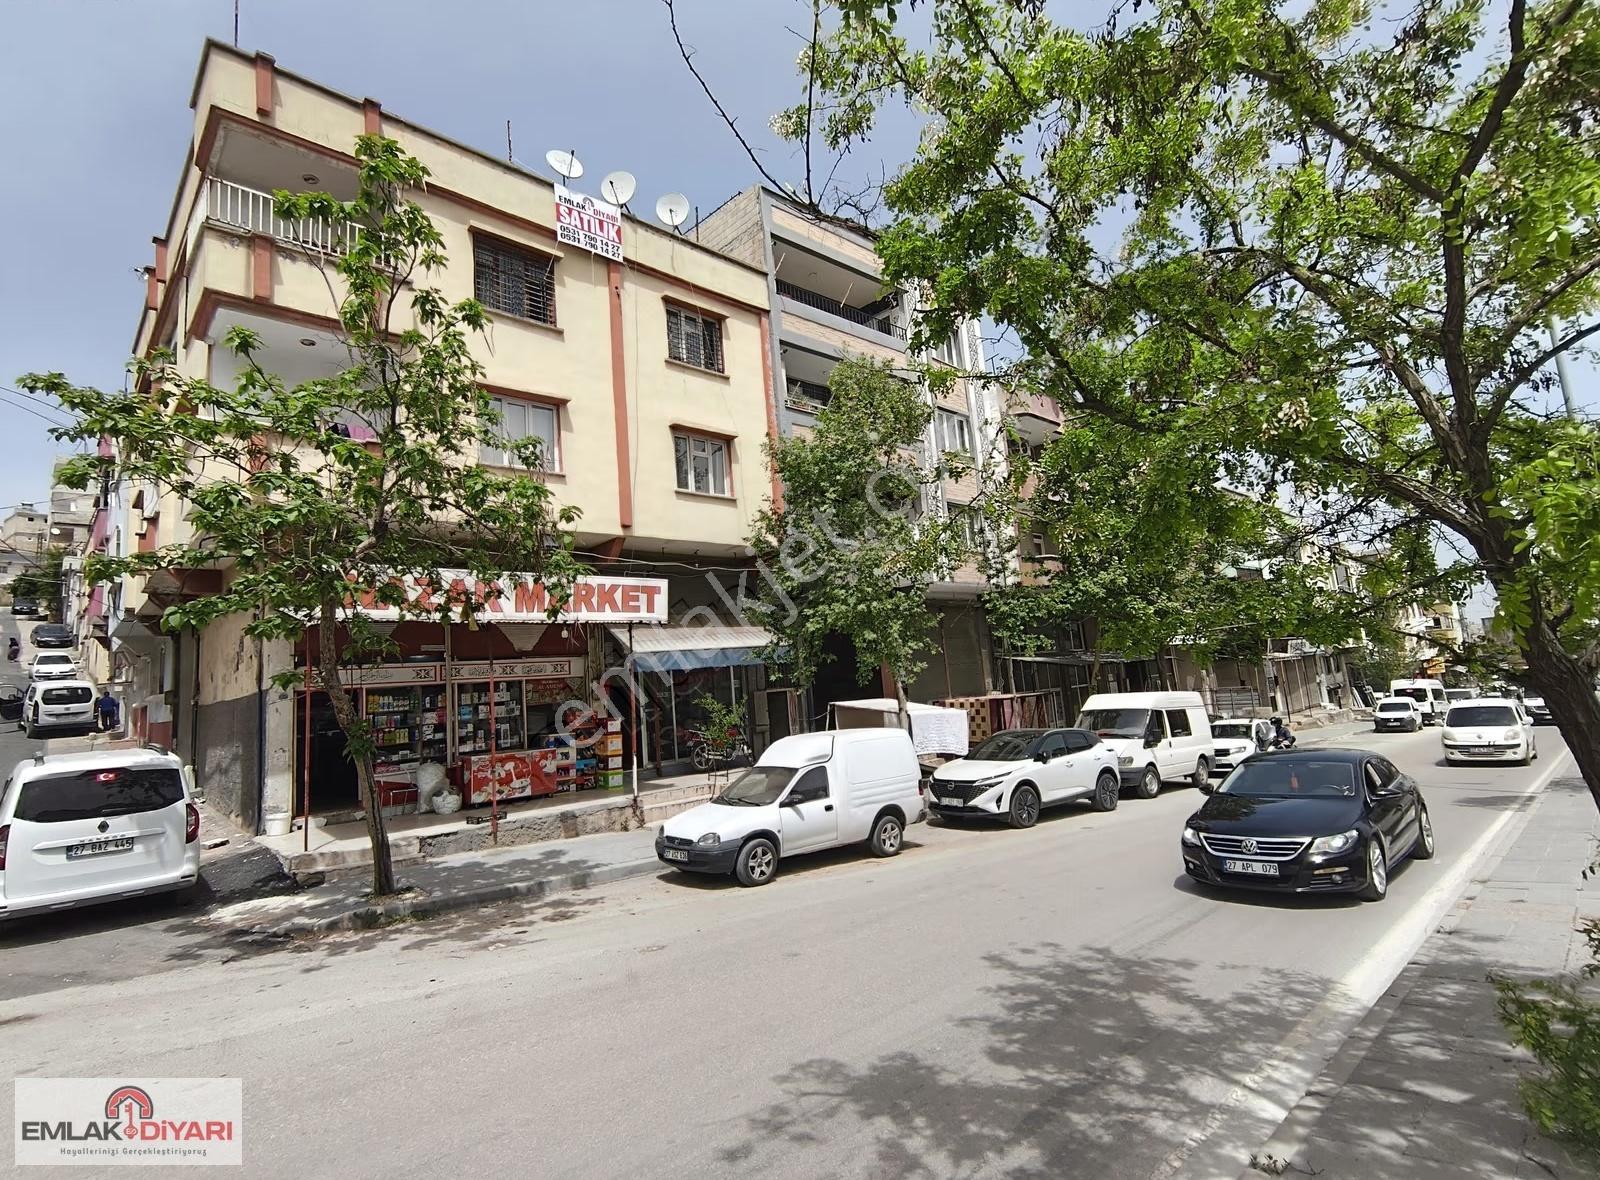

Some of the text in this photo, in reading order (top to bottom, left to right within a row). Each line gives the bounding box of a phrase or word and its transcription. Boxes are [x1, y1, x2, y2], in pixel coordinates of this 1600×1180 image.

[559, 195, 586, 211] EMLAK
[559, 205, 621, 245] SATILIK
[560, 224, 621, 252] 0531 790 14 27
[560, 233, 621, 259] 0531 790 14 27
[514, 581, 662, 614] MARKET
[73, 839, 132, 856] 27 BAZ 445
[1227, 861, 1278, 873] 27 APL 079
